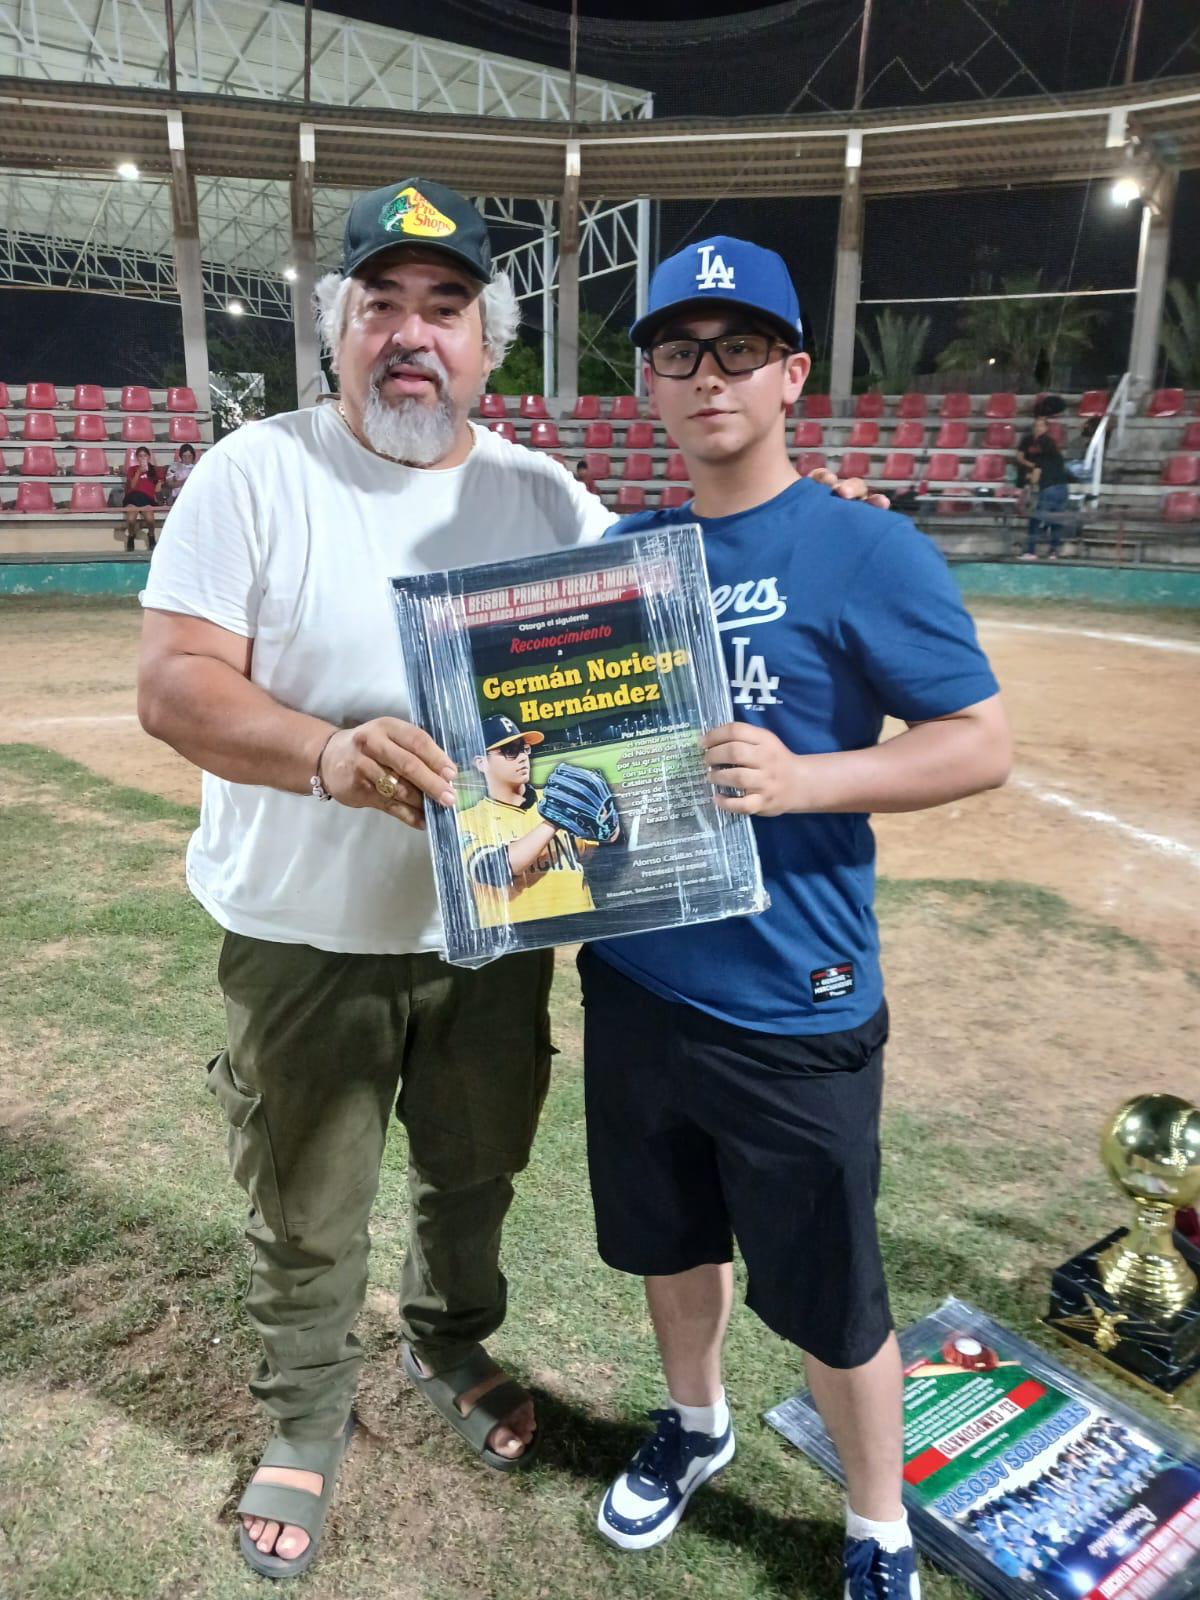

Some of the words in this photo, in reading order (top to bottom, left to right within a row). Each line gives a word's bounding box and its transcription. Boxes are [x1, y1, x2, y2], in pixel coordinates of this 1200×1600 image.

[696, 246, 736, 290] LA
[510, 625, 612, 653] Reconocimiento
[519, 621, 546, 631] Otorga
[547, 618, 554, 627] el
[555, 613, 590, 626] siguiente
[482, 665, 583, 700] Germán
[586, 650, 690, 683] Noriega
[730, 636, 780, 705] LA
[519, 683, 661, 723] Hernández
[636, 727, 658, 737] haber
[617, 762, 630, 771] por
[998, 1400, 1019, 1415] EL
[938, 1409, 1004, 1455] CAMPEONATO
[1003, 1401, 1091, 1470] SERVICIOS
[934, 1458, 1010, 1520] ACOSTA
